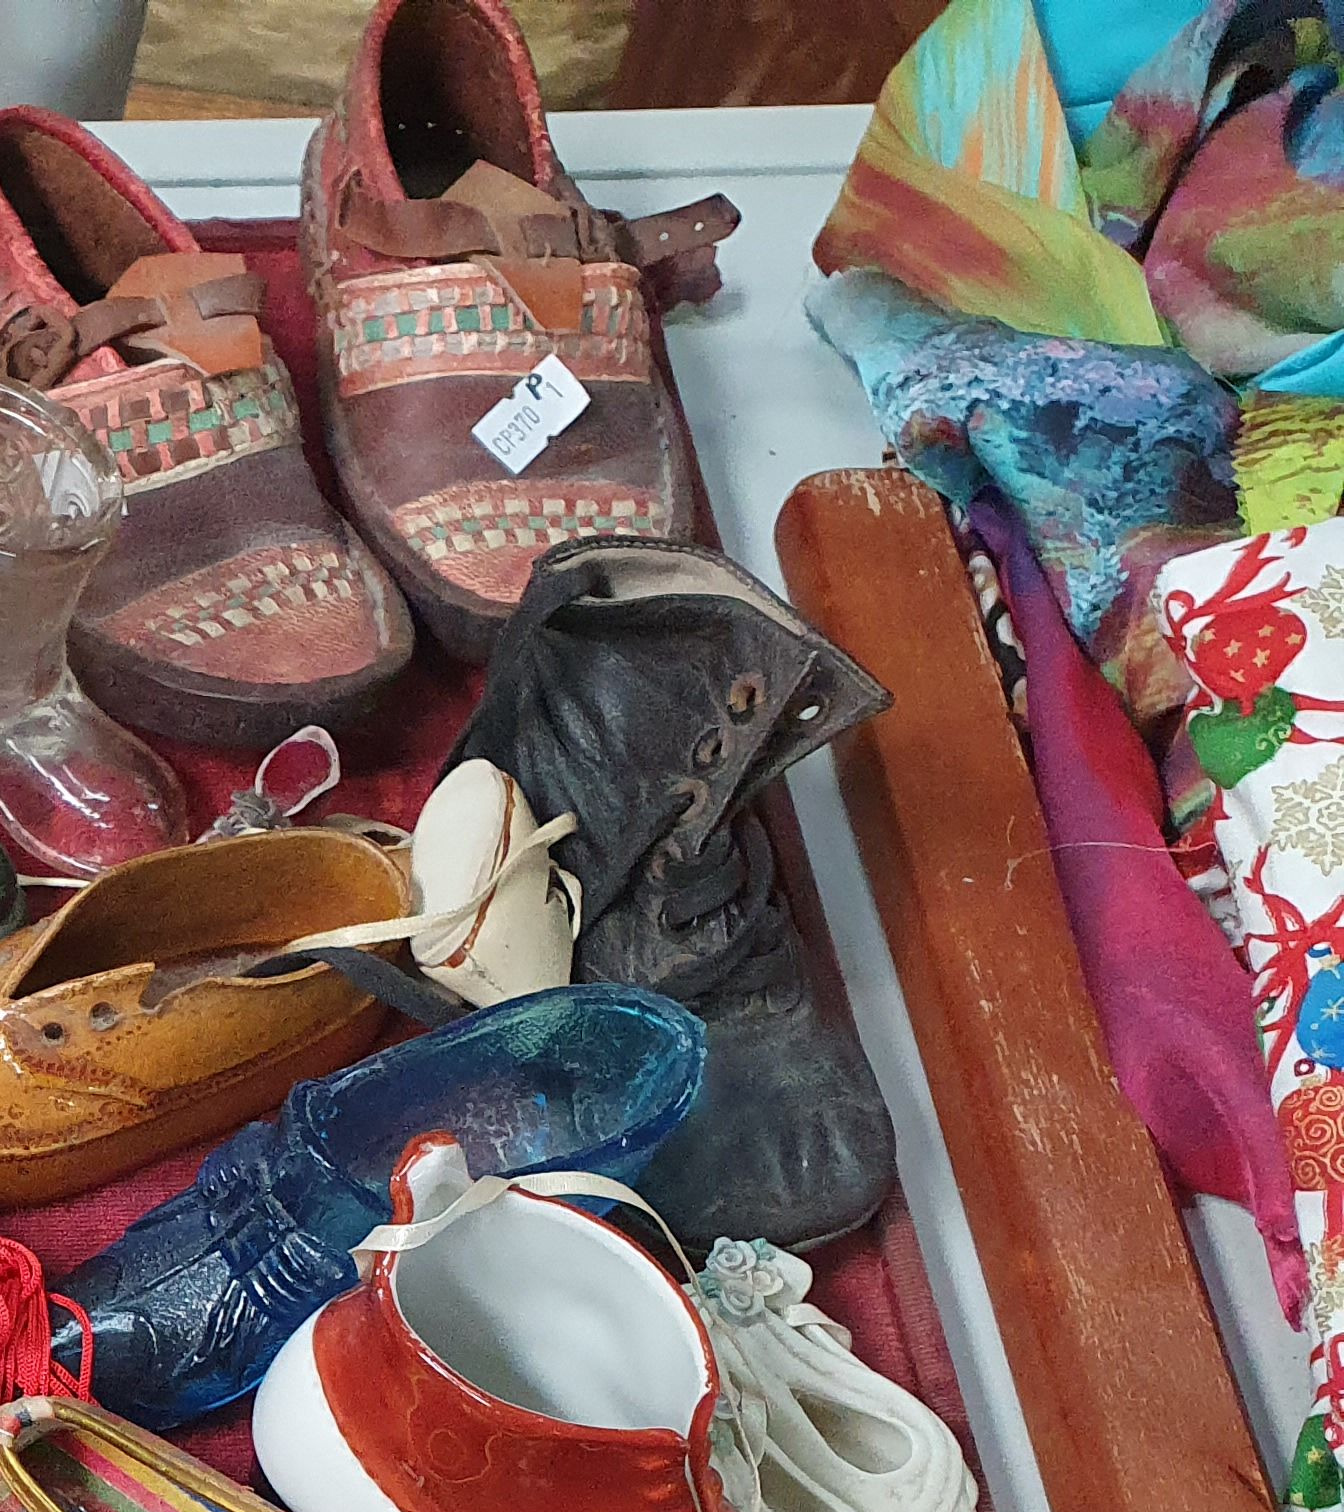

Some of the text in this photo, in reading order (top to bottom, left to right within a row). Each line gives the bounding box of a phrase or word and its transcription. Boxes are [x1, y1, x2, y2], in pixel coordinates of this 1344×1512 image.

[525, 373, 543, 401] P
[491, 381, 564, 456] CP370 1
